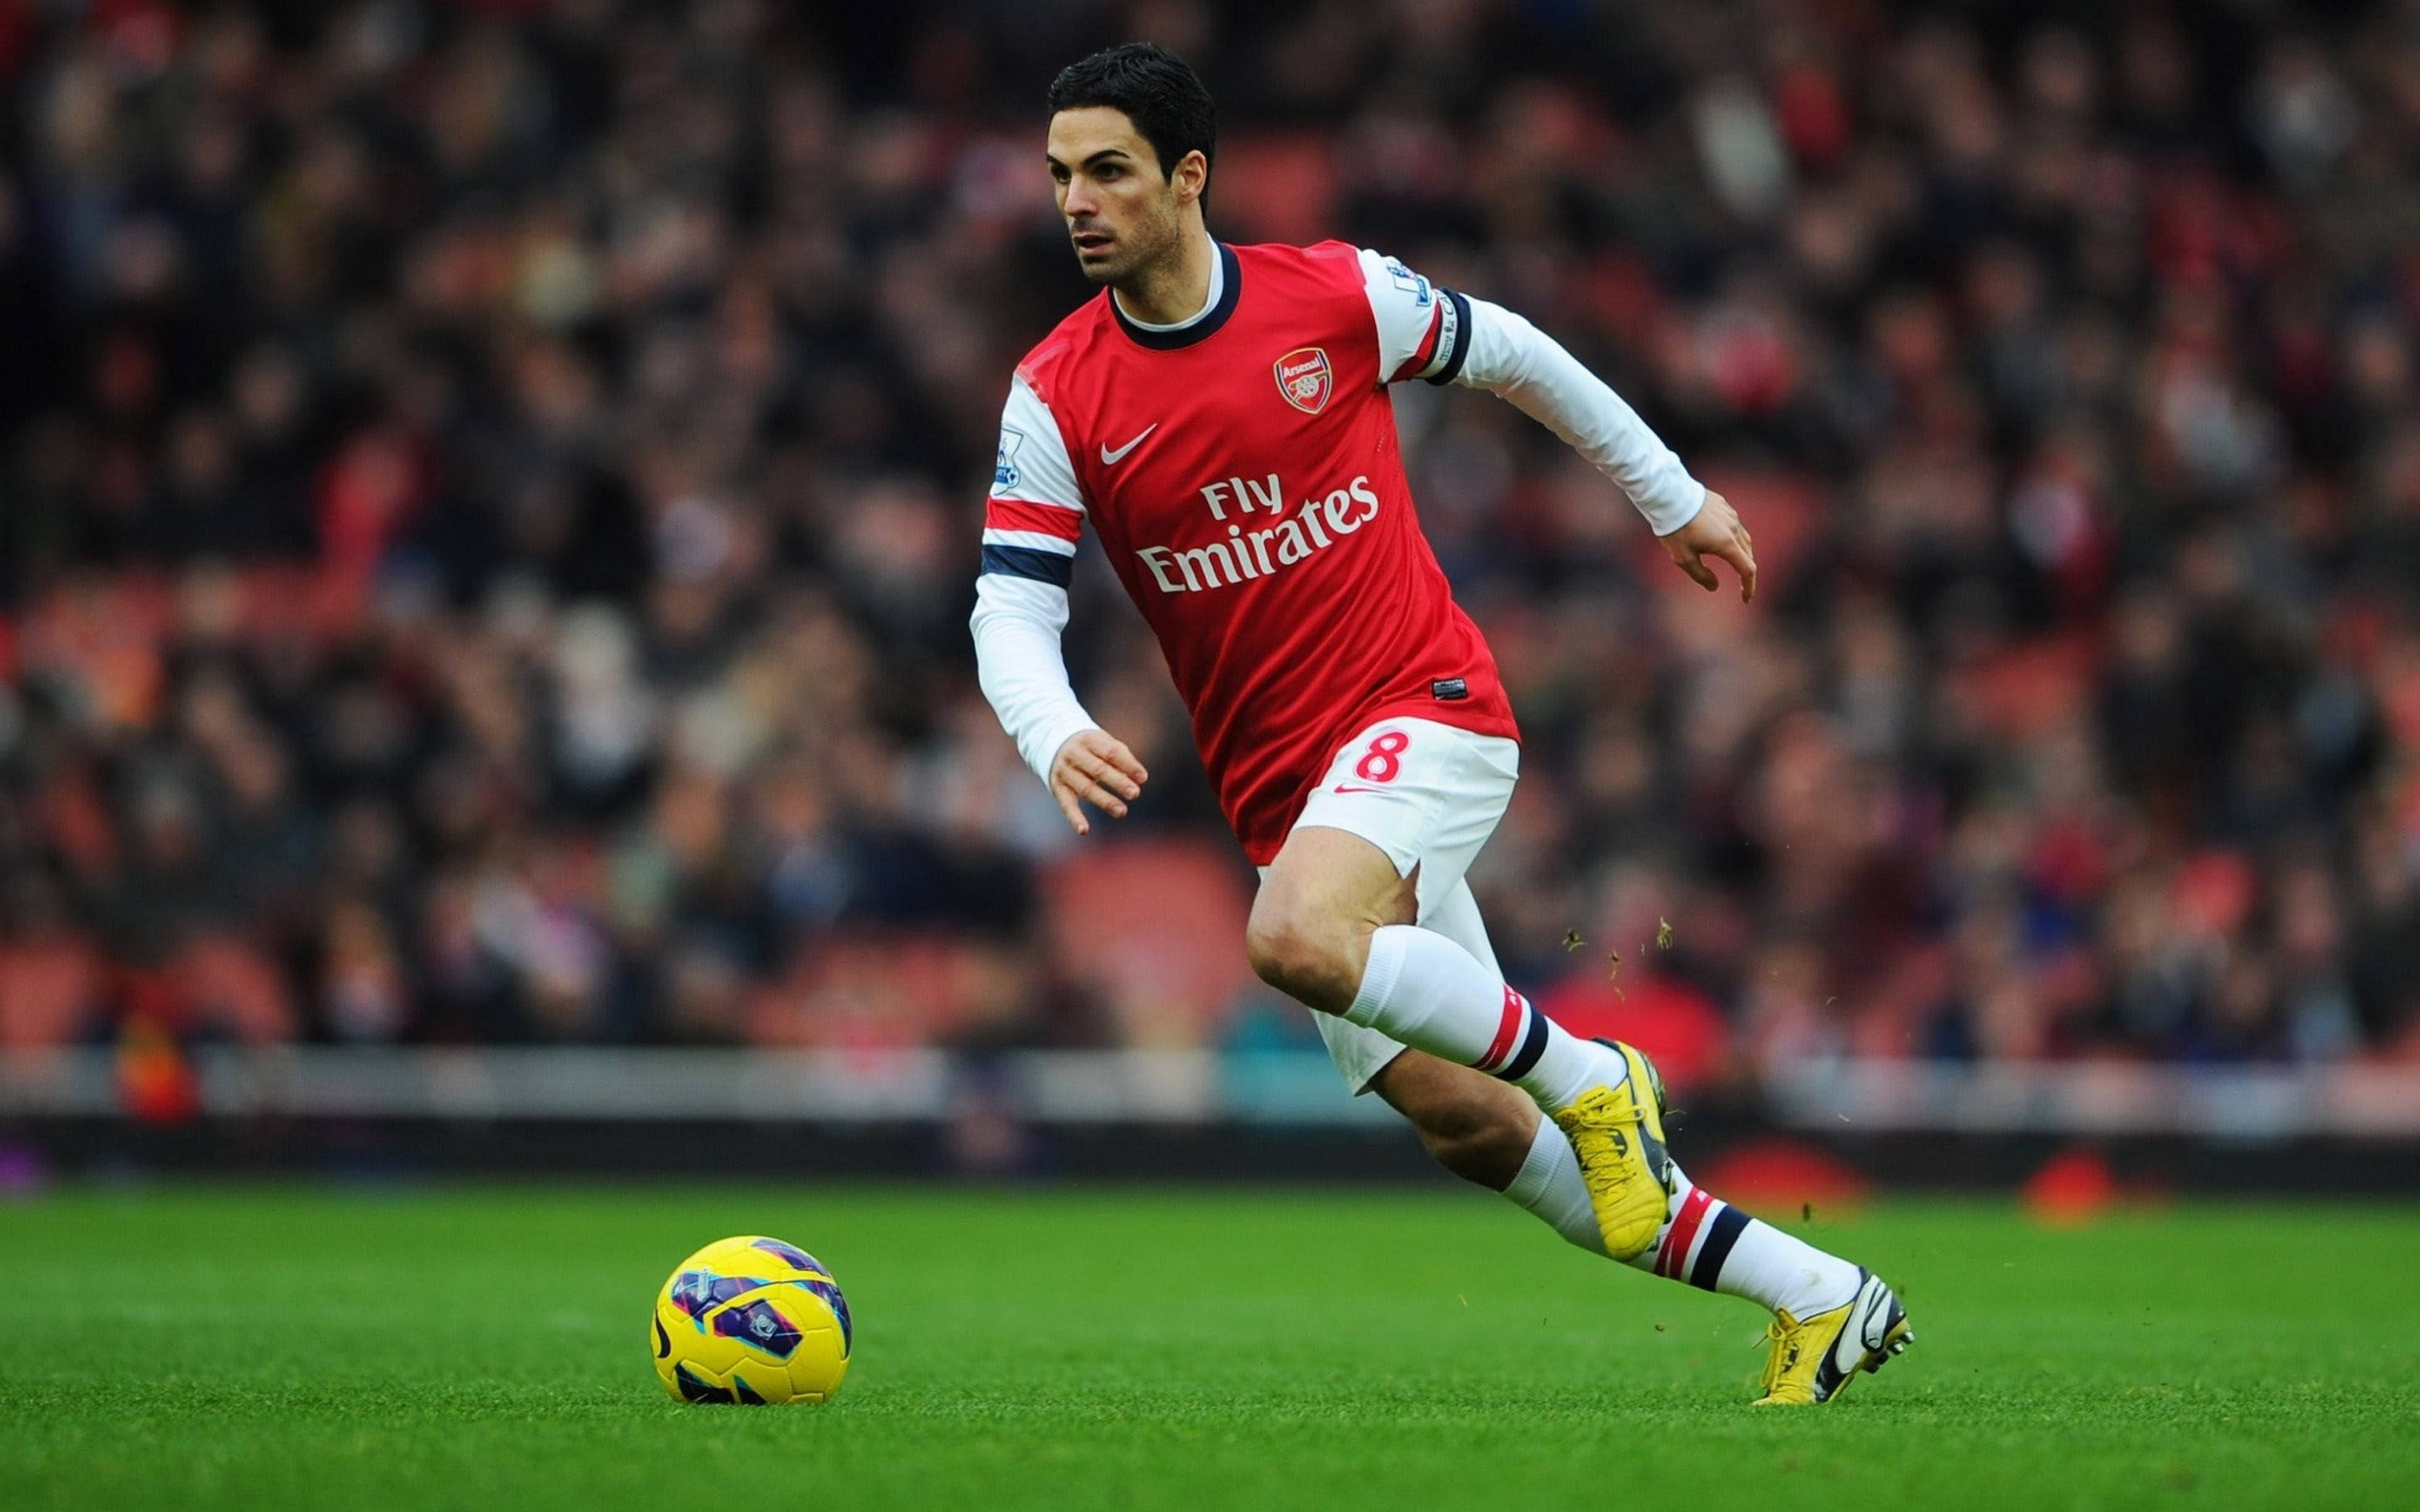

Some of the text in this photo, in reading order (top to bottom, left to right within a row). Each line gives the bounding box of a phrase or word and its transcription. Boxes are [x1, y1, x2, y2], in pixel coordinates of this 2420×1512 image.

[1200, 474, 1282, 521] Fly
[1135, 475, 1379, 592] Emirates
[1355, 731, 1409, 783] 8
